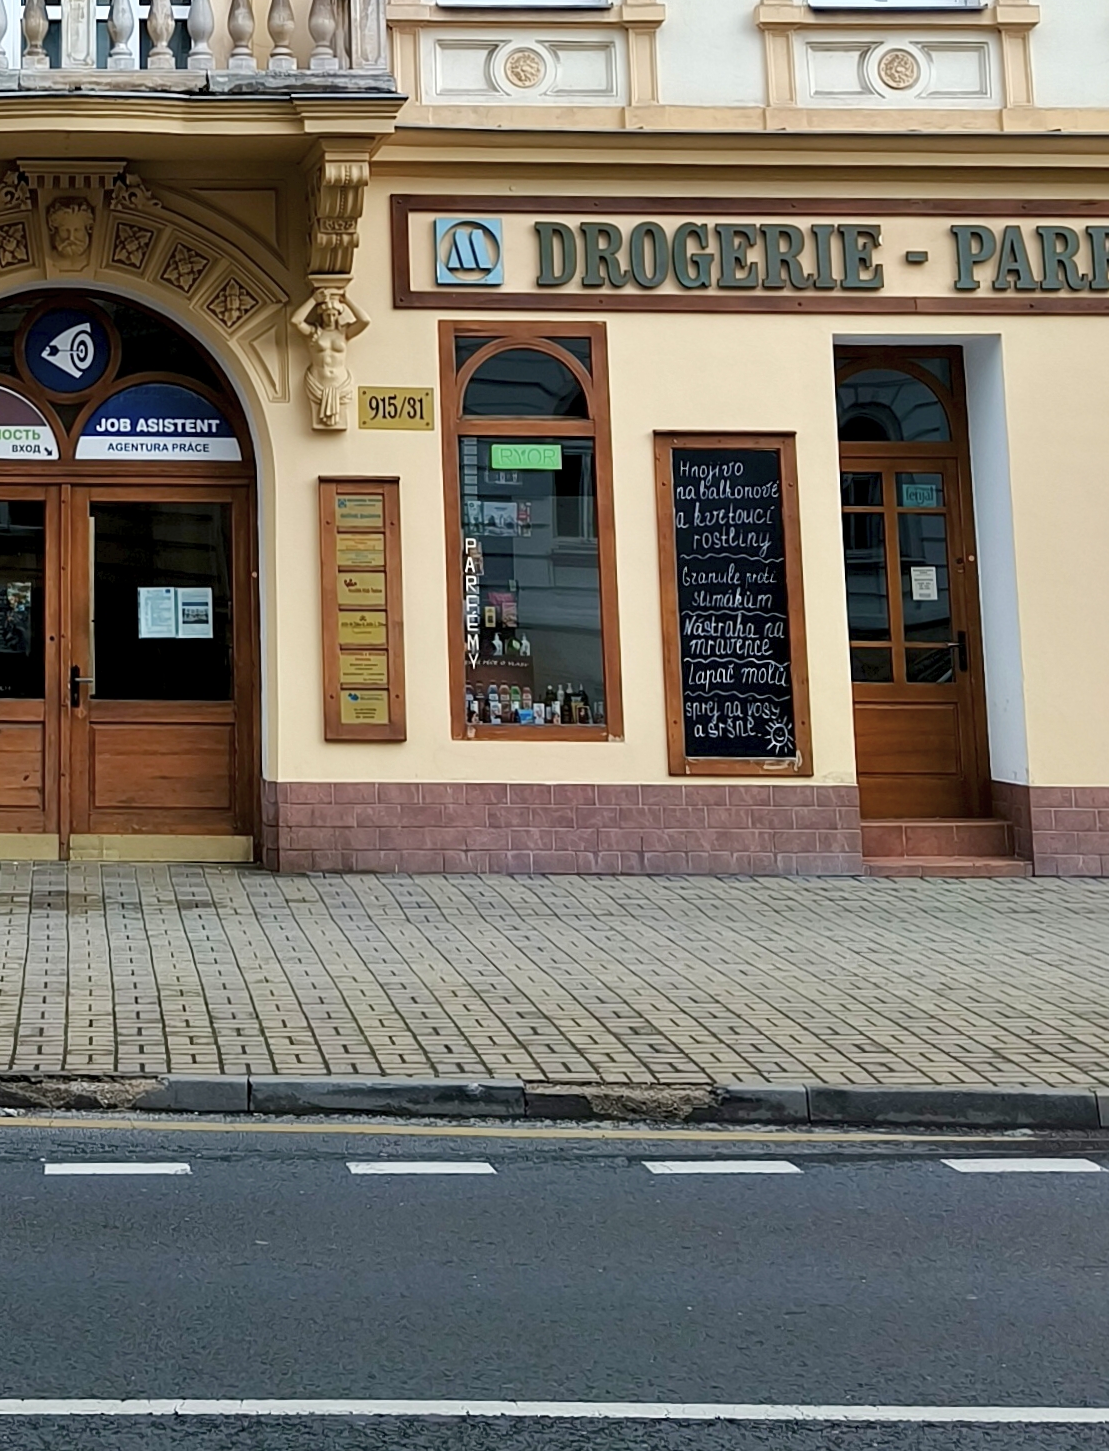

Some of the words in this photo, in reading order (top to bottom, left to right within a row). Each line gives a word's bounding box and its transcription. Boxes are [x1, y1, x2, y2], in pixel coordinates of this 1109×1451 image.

[534, 220, 884, 289] DROGERIE
[368, 394, 425, 421] 915/31
[95, 418, 131, 433] JOB
[136, 418, 220, 433] ASISTENT
[12, 444, 41, 454] ВХОД
[107, 442, 169, 452] AGENTURA
[172, 441, 210, 453] PRÁCE
[499, 447, 557, 466] RYOR
[680, 460, 744, 486] Hnojivo
[676, 485, 697, 500] na
[700, 479, 780, 500] balkonové
[676, 511, 689, 528] a
[694, 502, 775, 527] kvetoucí
[693, 526, 772, 558] rostliny
[682, 563, 741, 586] Granule
[745, 567, 777, 589] proti
[464, 537, 480, 670] PARFÉMY
[683, 613, 760, 638] Nástraha
[764, 621, 785, 638] na
[689, 638, 773, 657] mravence
[724, 701, 744, 717] na
[694, 724, 706, 738] a
